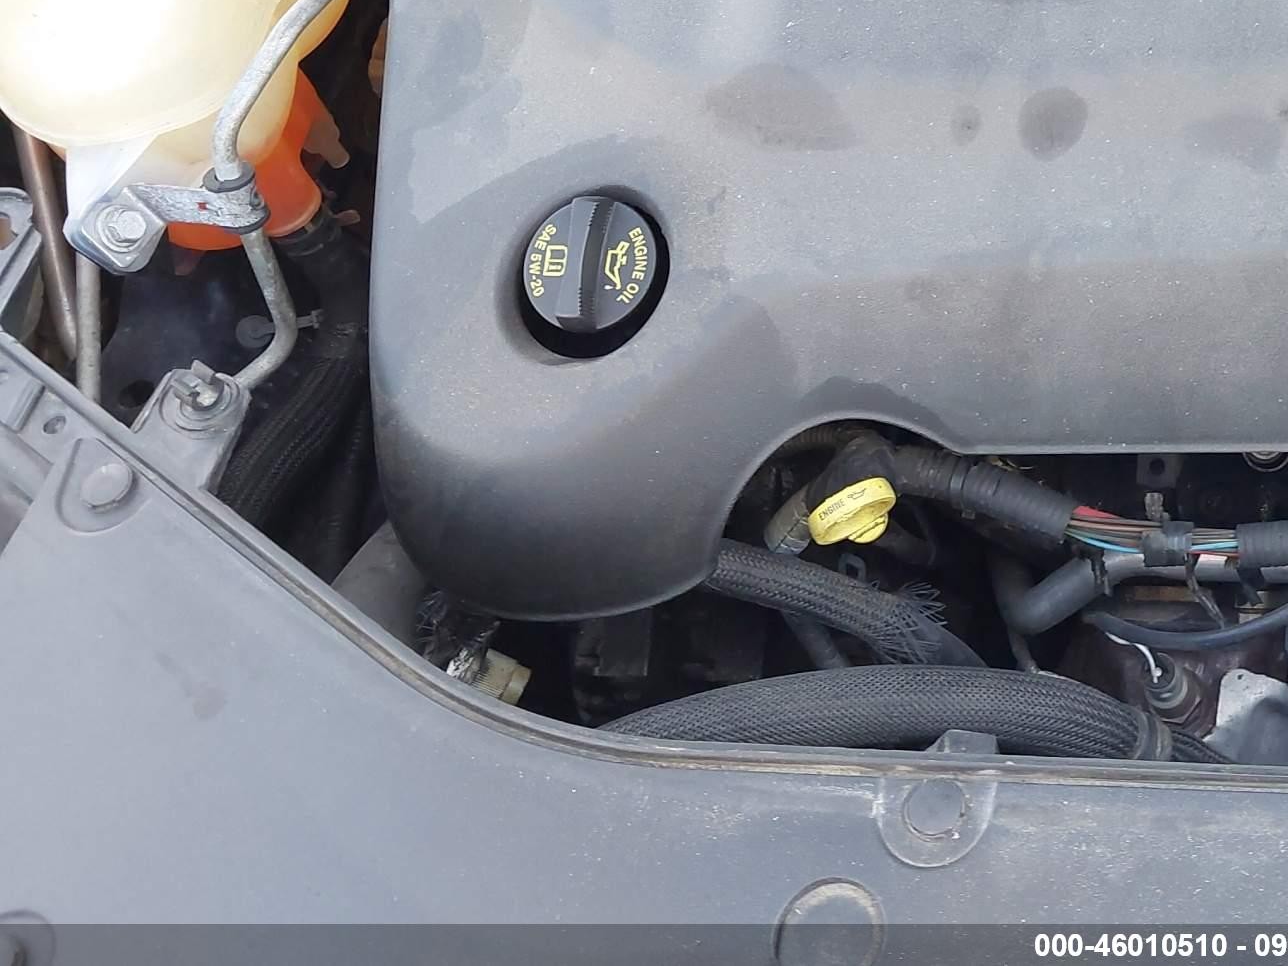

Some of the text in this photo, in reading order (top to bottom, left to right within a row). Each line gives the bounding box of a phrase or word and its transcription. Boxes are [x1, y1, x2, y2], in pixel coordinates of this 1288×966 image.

[528, 223, 558, 298] SAE 5W-20
[615, 226, 648, 304] ENGINE OIL
[818, 498, 846, 521] ENGINE
